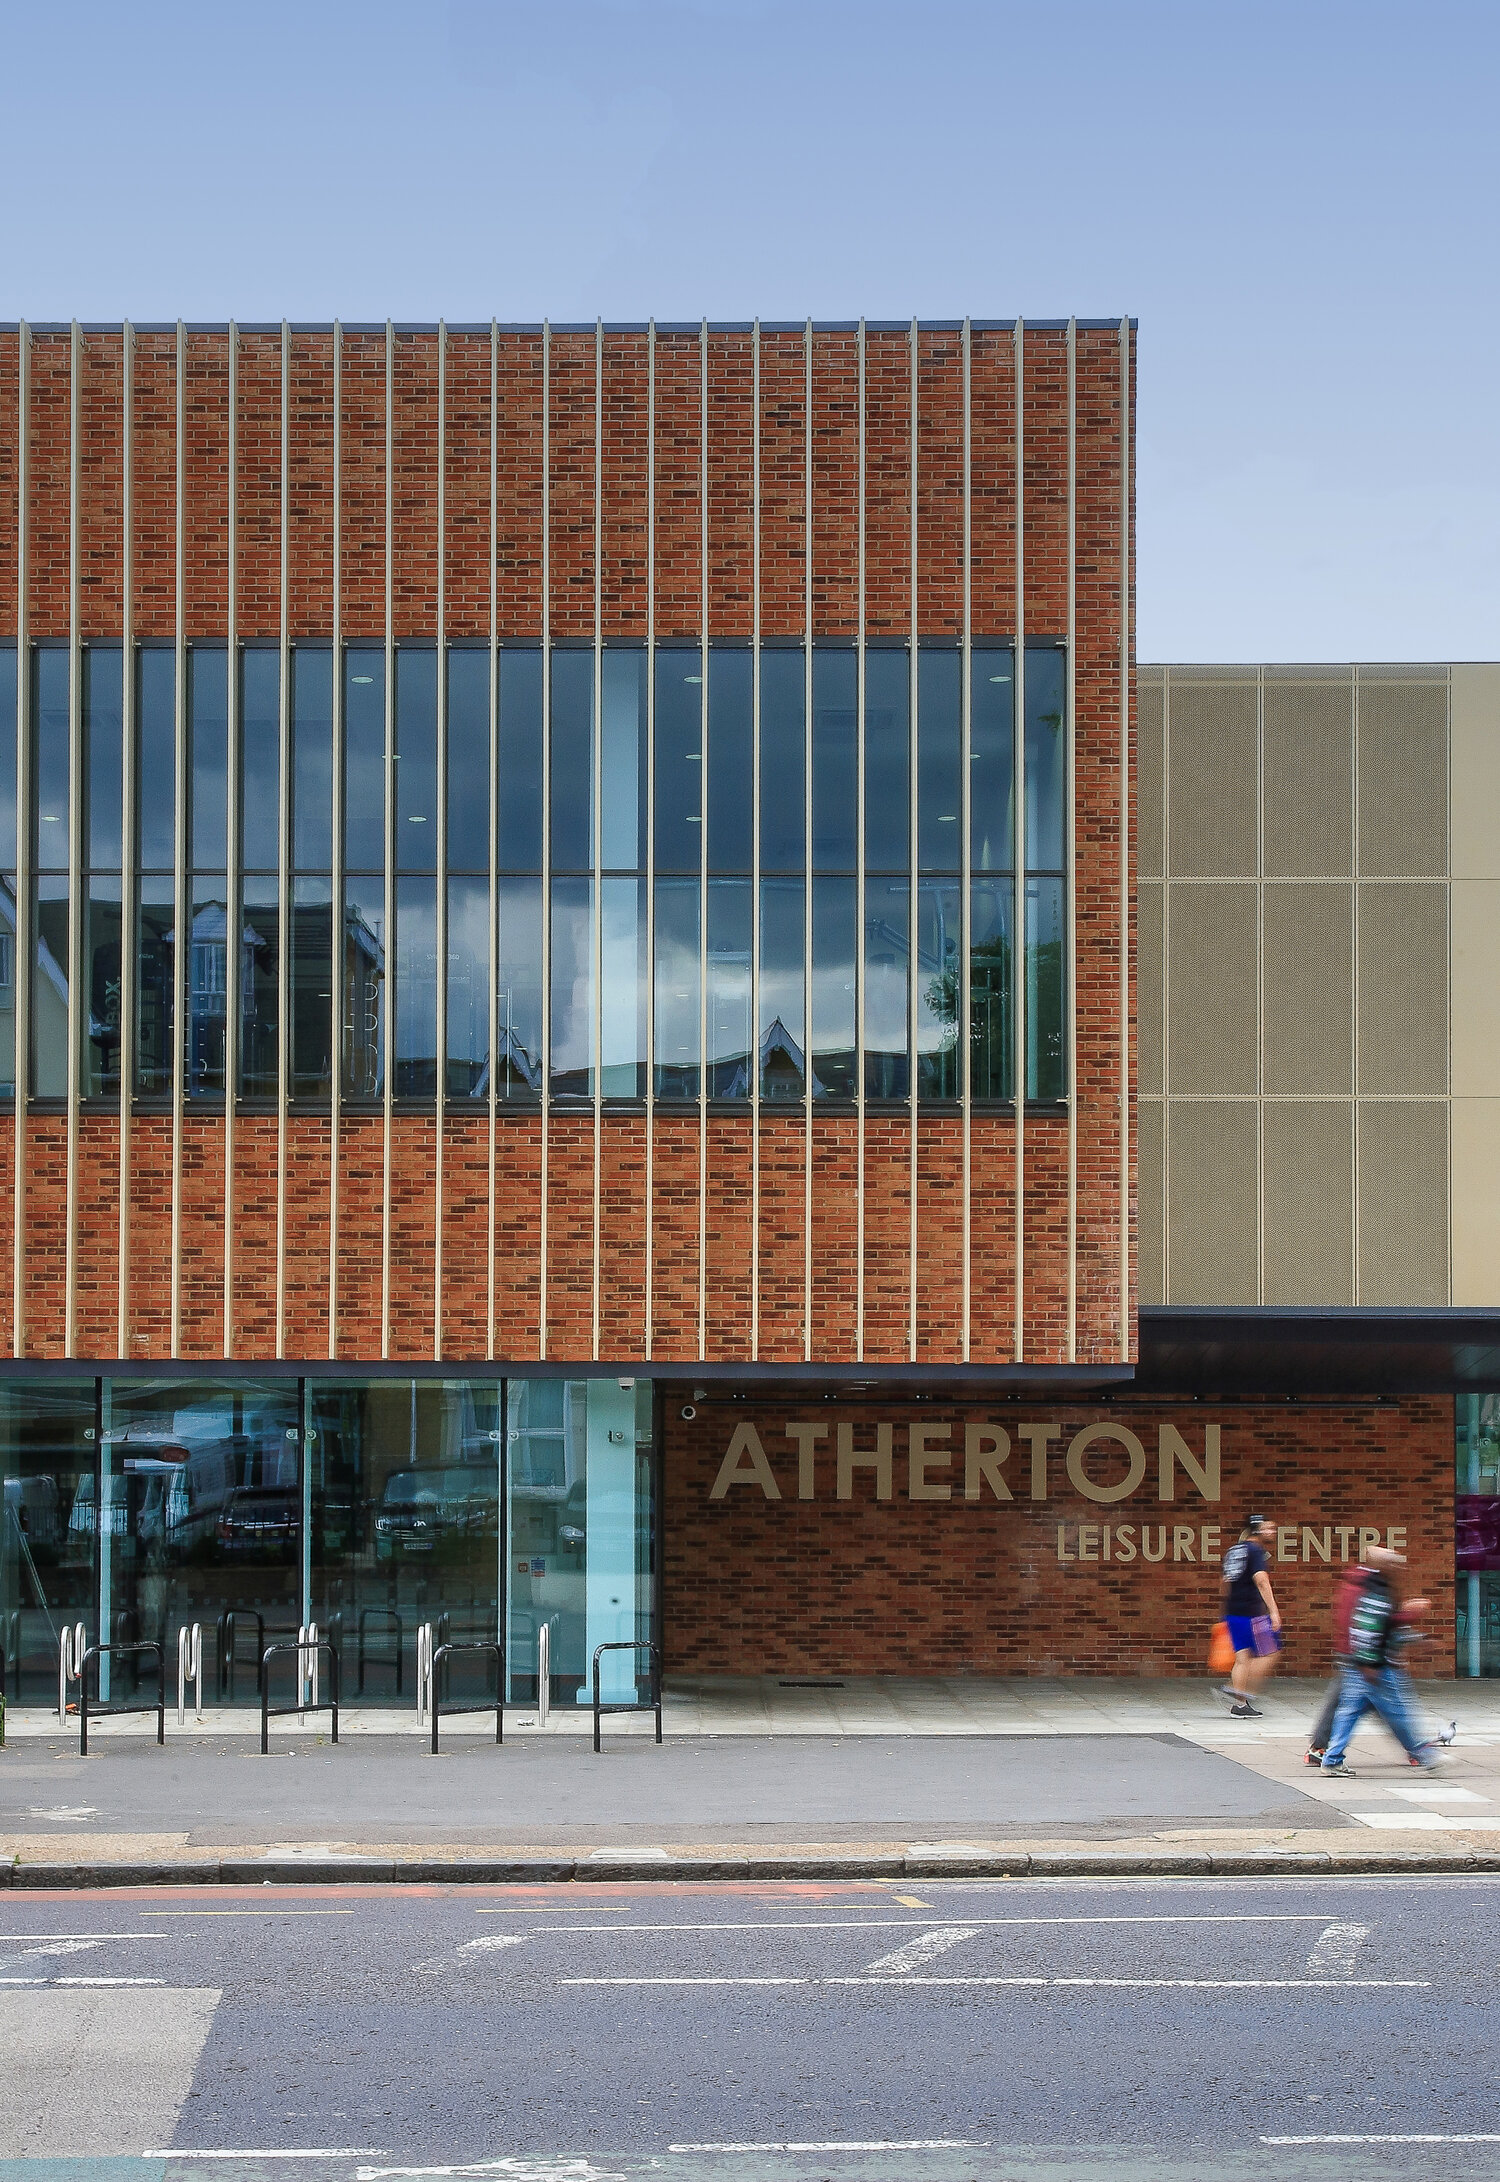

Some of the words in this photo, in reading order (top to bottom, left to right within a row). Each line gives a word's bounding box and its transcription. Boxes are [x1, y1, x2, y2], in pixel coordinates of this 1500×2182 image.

[709, 1422, 1221, 1502] ATHERTON
[1057, 1525, 1221, 1562] LEISURE
[1238, 1526, 1407, 1562] ENTRE
